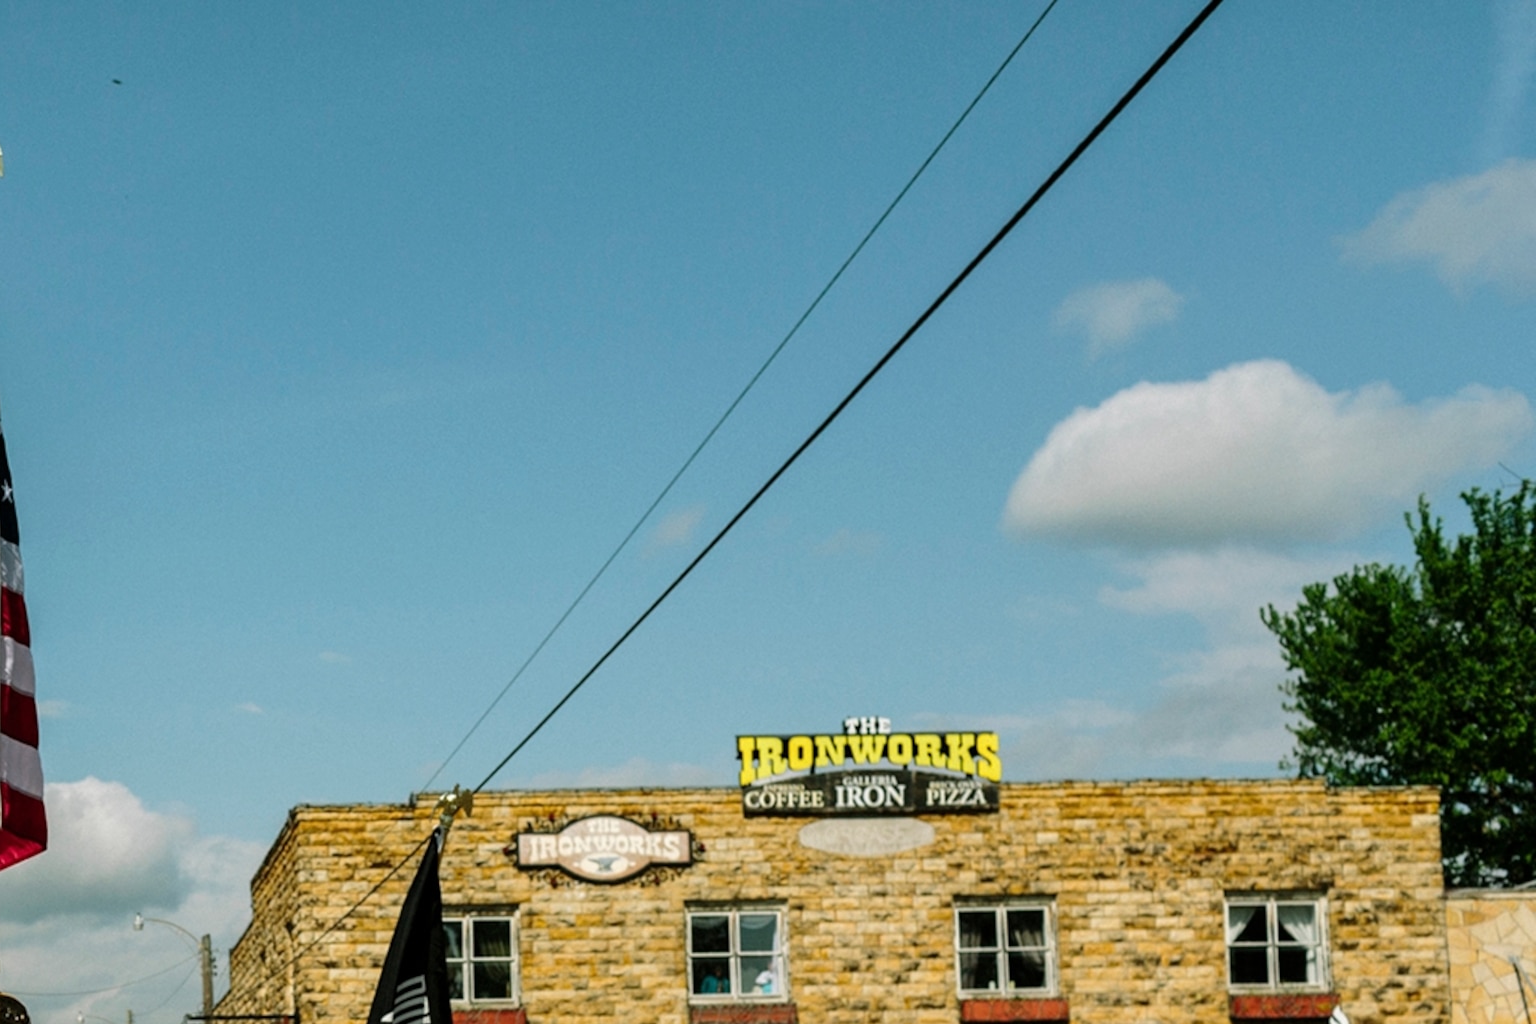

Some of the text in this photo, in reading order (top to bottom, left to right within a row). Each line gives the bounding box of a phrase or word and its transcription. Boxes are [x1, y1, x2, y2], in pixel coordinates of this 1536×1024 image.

[843, 717, 891, 734] THE
[737, 732, 1003, 786] IRONWORKS
[842, 775, 898, 787] GALLERIA
[744, 790, 825, 809] COFFEE
[835, 784, 906, 808] IRON
[926, 787, 987, 807] PIZZA
[587, 820, 620, 833] THE
[529, 834, 681, 864] IRONWORKS
